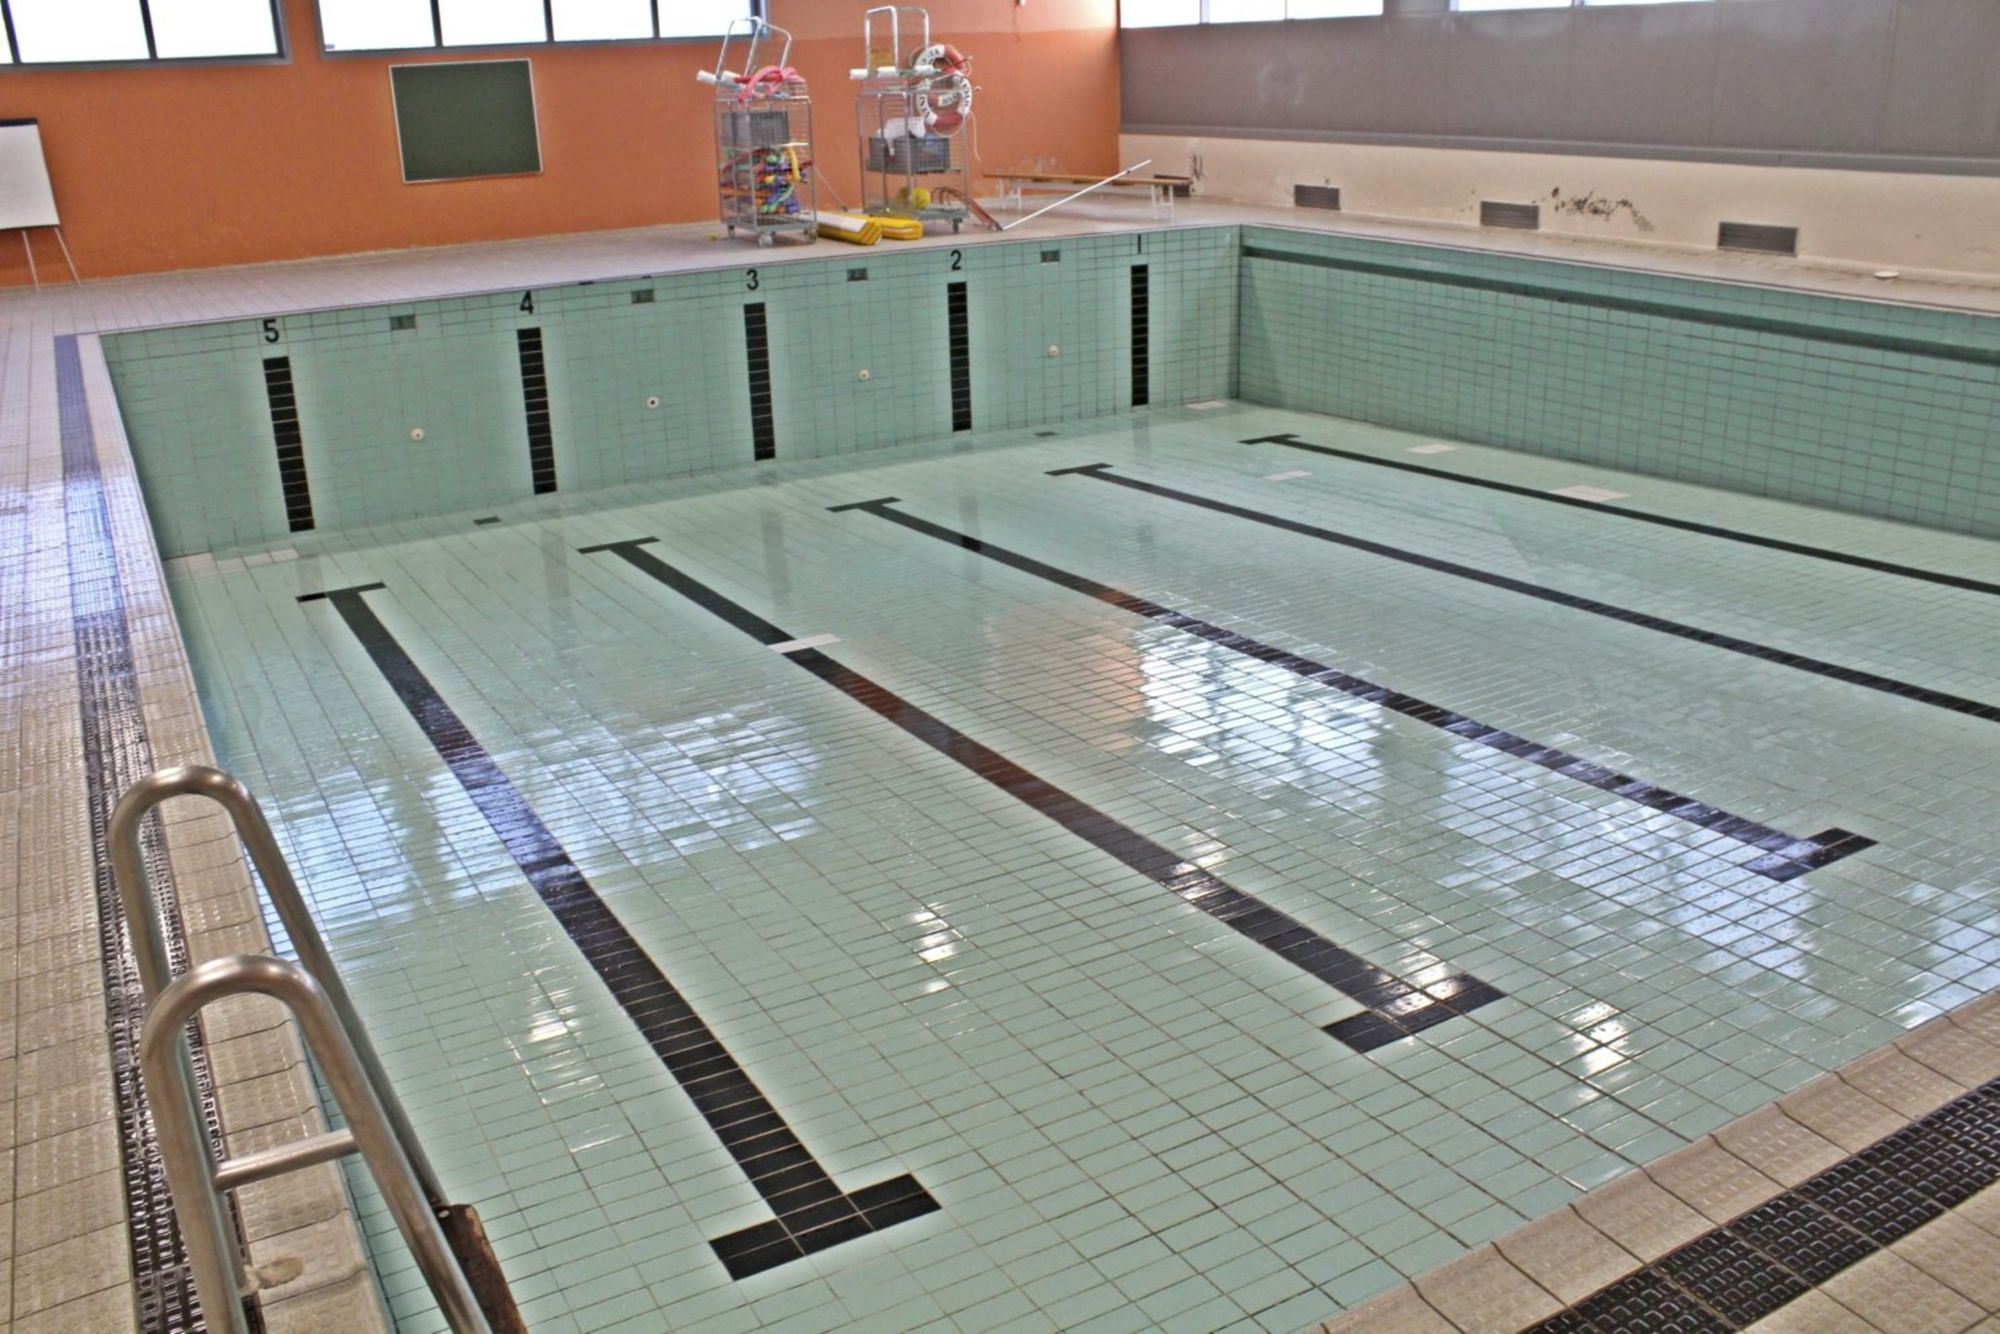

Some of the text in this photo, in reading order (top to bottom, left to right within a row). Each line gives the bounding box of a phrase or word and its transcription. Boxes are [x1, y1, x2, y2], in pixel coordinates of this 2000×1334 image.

[950, 249, 962, 271] 2
[746, 268, 759, 291] 3
[519, 290, 534, 315] 4
[263, 318, 279, 343] 5
